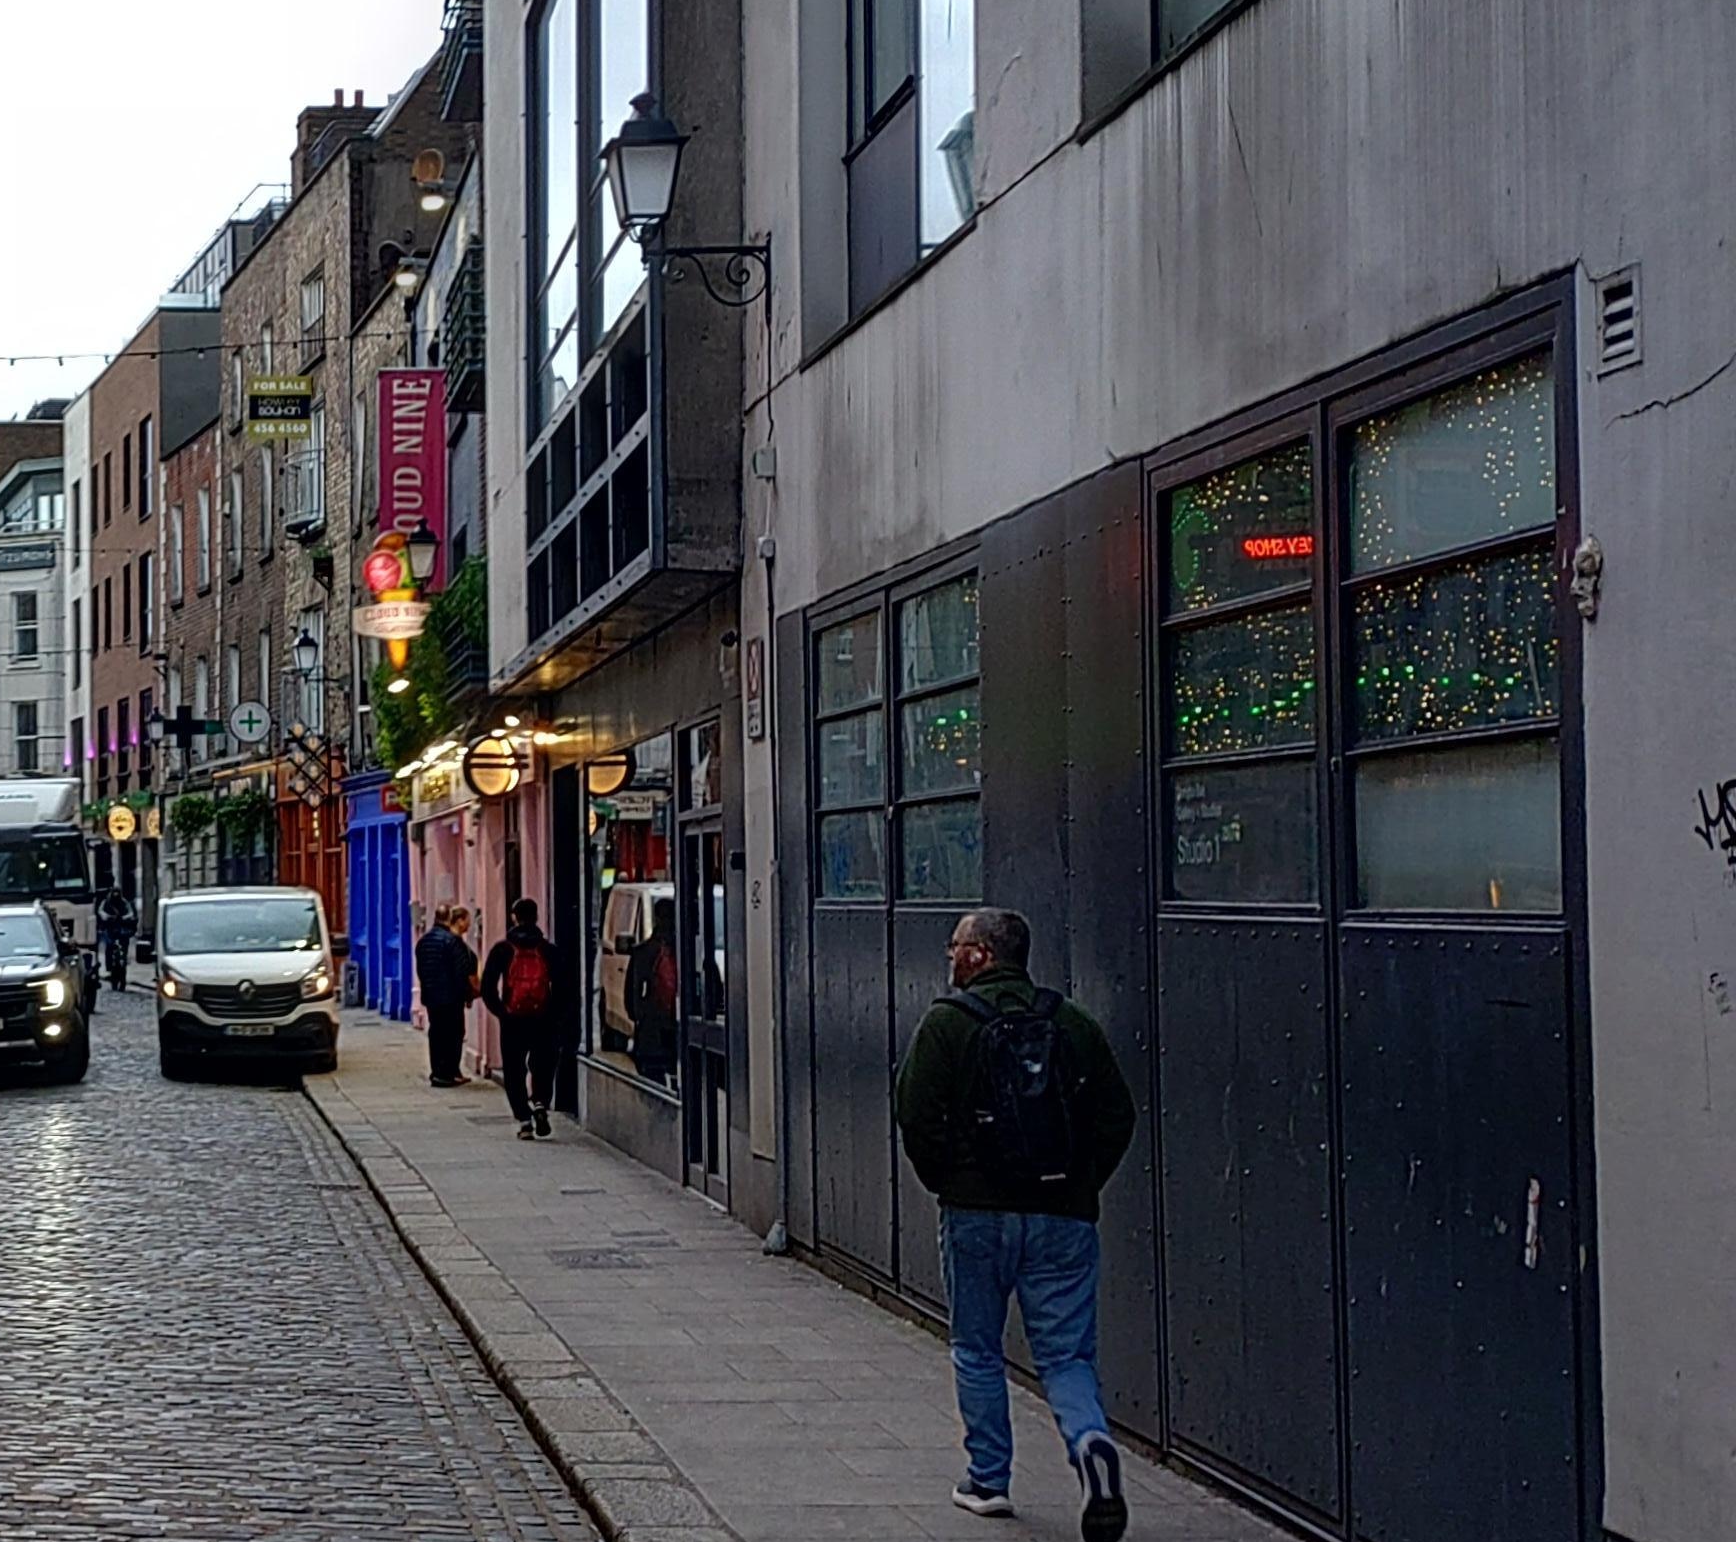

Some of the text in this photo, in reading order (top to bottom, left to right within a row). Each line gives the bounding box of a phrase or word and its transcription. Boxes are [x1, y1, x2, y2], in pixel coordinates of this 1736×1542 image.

[254, 381, 307, 390] FOR SALE
[254, 423, 275, 433] 456
[392, 378, 432, 534] OUD NINE
